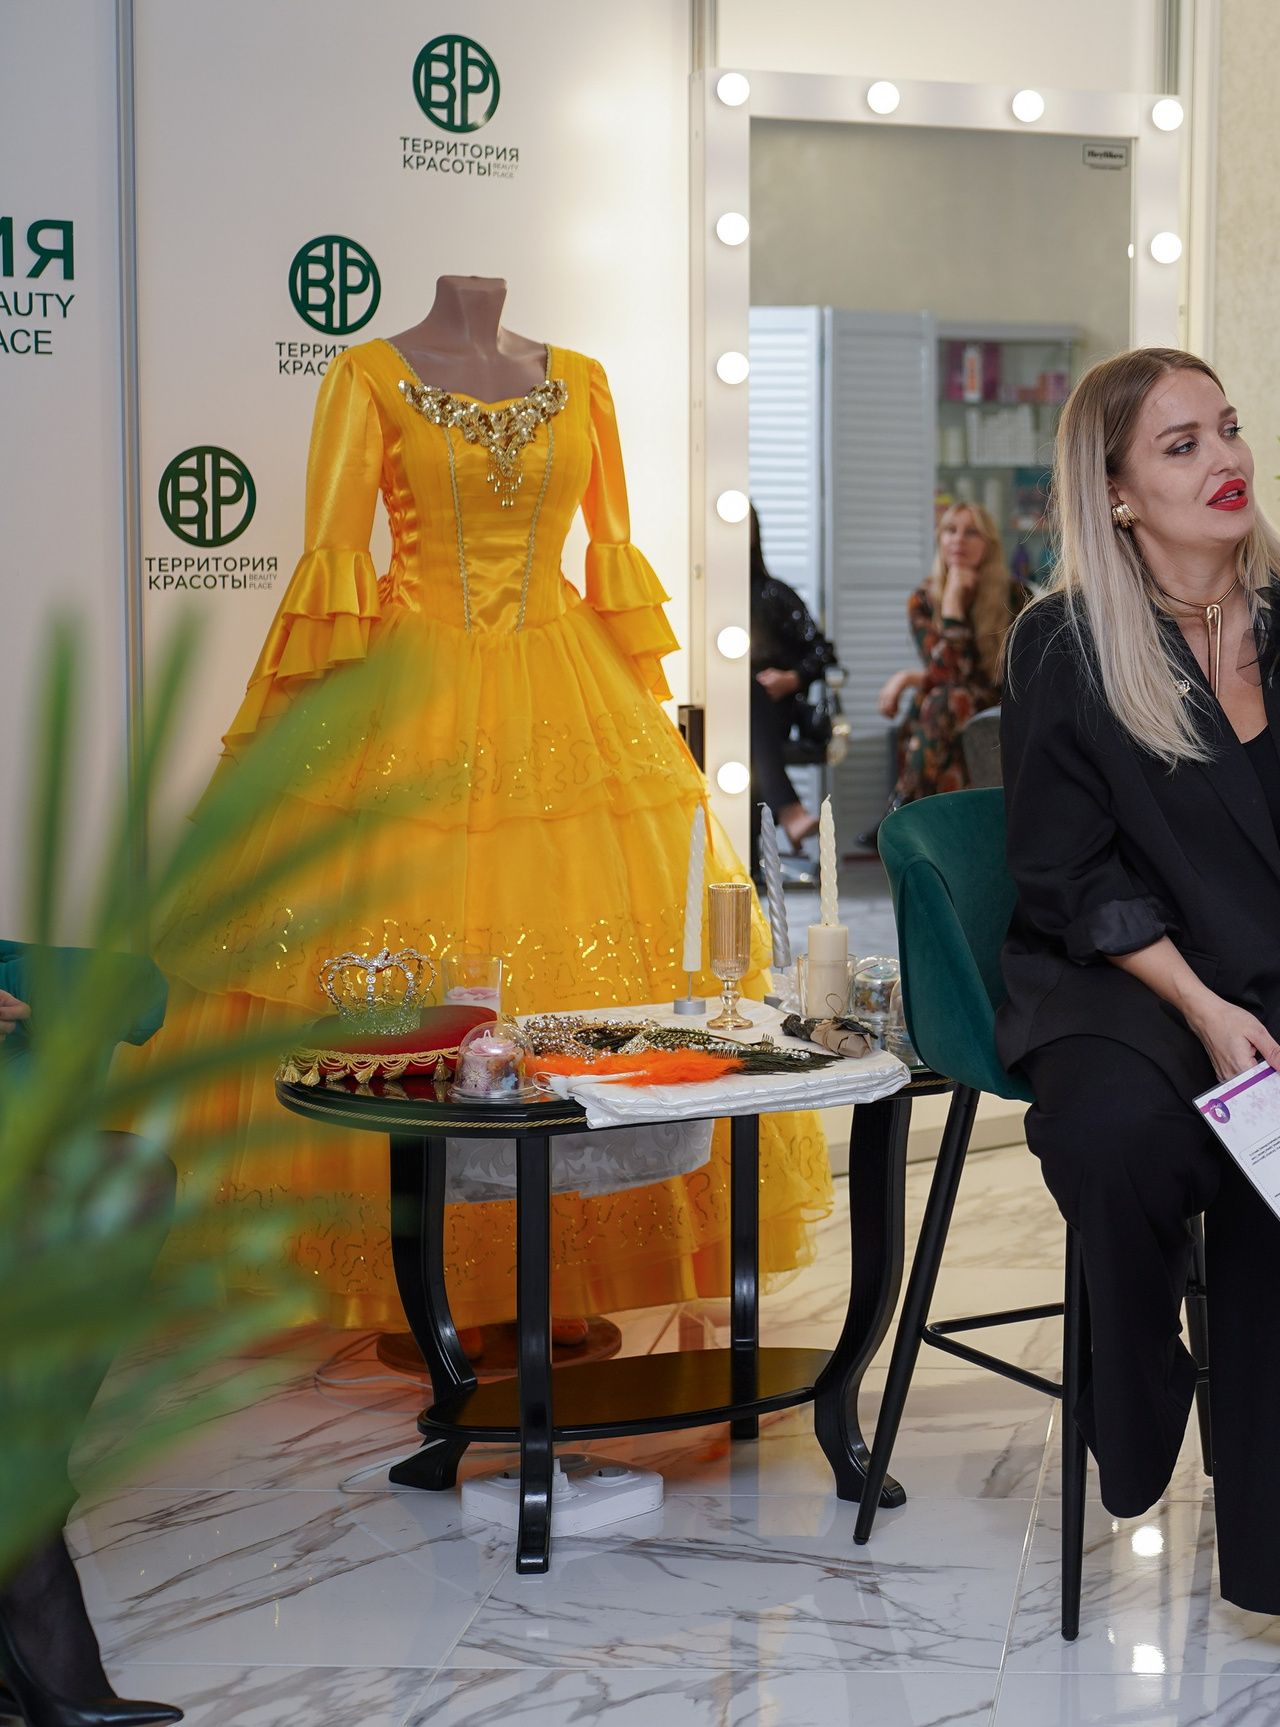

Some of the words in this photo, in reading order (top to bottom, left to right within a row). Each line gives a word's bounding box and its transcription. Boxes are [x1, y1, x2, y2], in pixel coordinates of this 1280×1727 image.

[400, 136, 519, 162] ТЕРРИТОРИЯ
[403, 155, 491, 177] КРАСОТЫ
[492, 163, 518, 171] BEAUTY
[145, 556, 278, 573] ТЕРРИТОРИЯ
[149, 574, 247, 591] КРАСОТЫ
[249, 573, 278, 582] BEAUTY
[249, 582, 273, 590] PLACE
